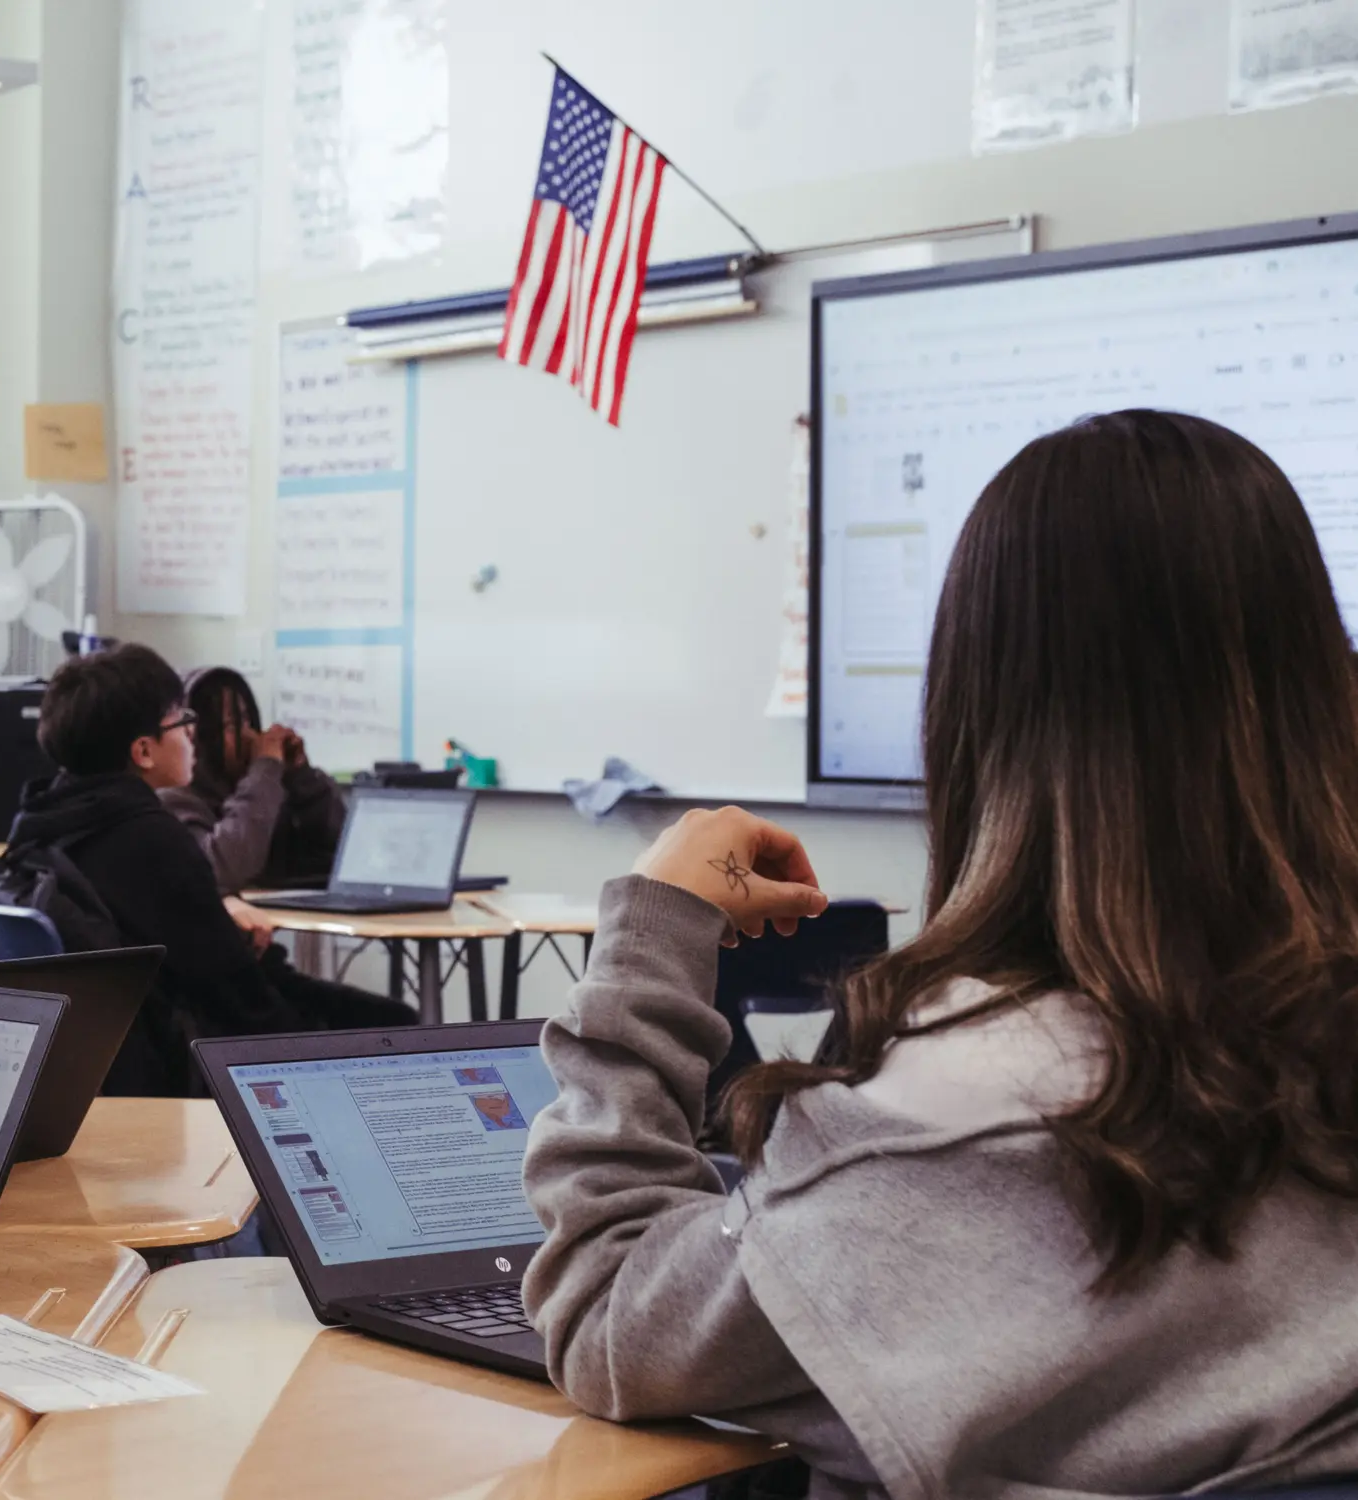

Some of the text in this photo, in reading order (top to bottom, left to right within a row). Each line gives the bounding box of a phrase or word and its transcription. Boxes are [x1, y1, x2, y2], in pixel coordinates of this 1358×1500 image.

[130, 75, 153, 110] R
[127, 171, 147, 198] A
[118, 308, 139, 344] C
[122, 448, 138, 482] E
[496, 1257, 510, 1272] hp
